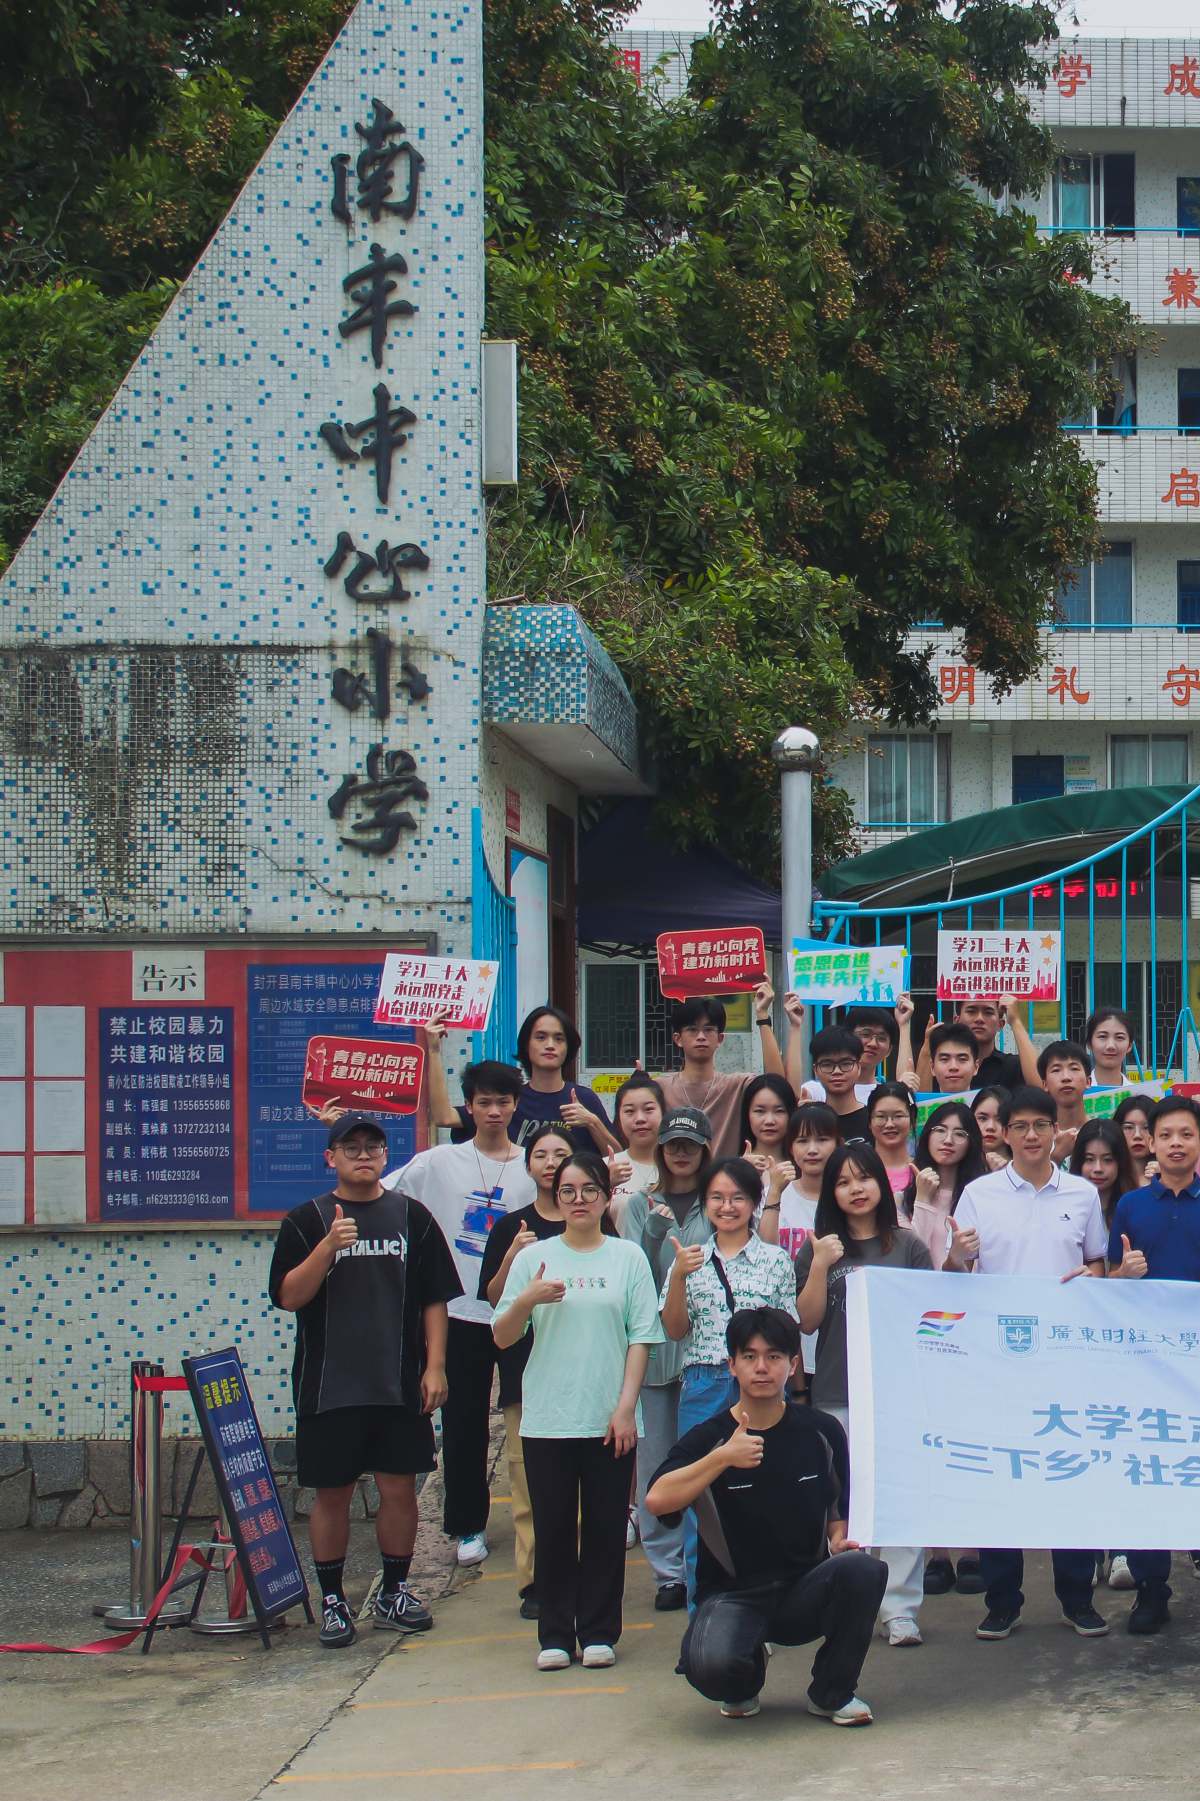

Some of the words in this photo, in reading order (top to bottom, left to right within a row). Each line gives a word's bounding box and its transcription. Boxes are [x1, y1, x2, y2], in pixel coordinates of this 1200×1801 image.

[320, 97, 431, 856] 南丰中心小学
[681, 937, 759, 957] 青春心向党
[952, 936, 1031, 955] 学习二十大
[396, 959, 470, 982] 学习二十大
[682, 952, 760, 970] 建功新时代
[794, 951, 871, 973] 感恩奋进
[952, 955, 1031, 974] 永远跟党走
[139, 964, 197, 994] 告示
[794, 968, 869, 990] 青年先行
[952, 973, 1031, 994] 奋进新征程
[393, 979, 466, 1002] 永远跟党走
[110, 1016, 225, 1036] 禁止校园暴力
[110, 1044, 226, 1064] 共建和谐校园
[332, 1049, 418, 1071] 青春心向党
[330, 1065, 416, 1086] 建功新时代
[105, 1100, 115, 1112] 组
[173, 1100, 231, 1111] 13556555868
[173, 1123, 231, 1135] 13727232134
[173, 1147, 231, 1158] 13556560725
[335, 1232, 408, 1270] TALLICA
[1047, 1324, 1200, 1353] 廣東財經大學
